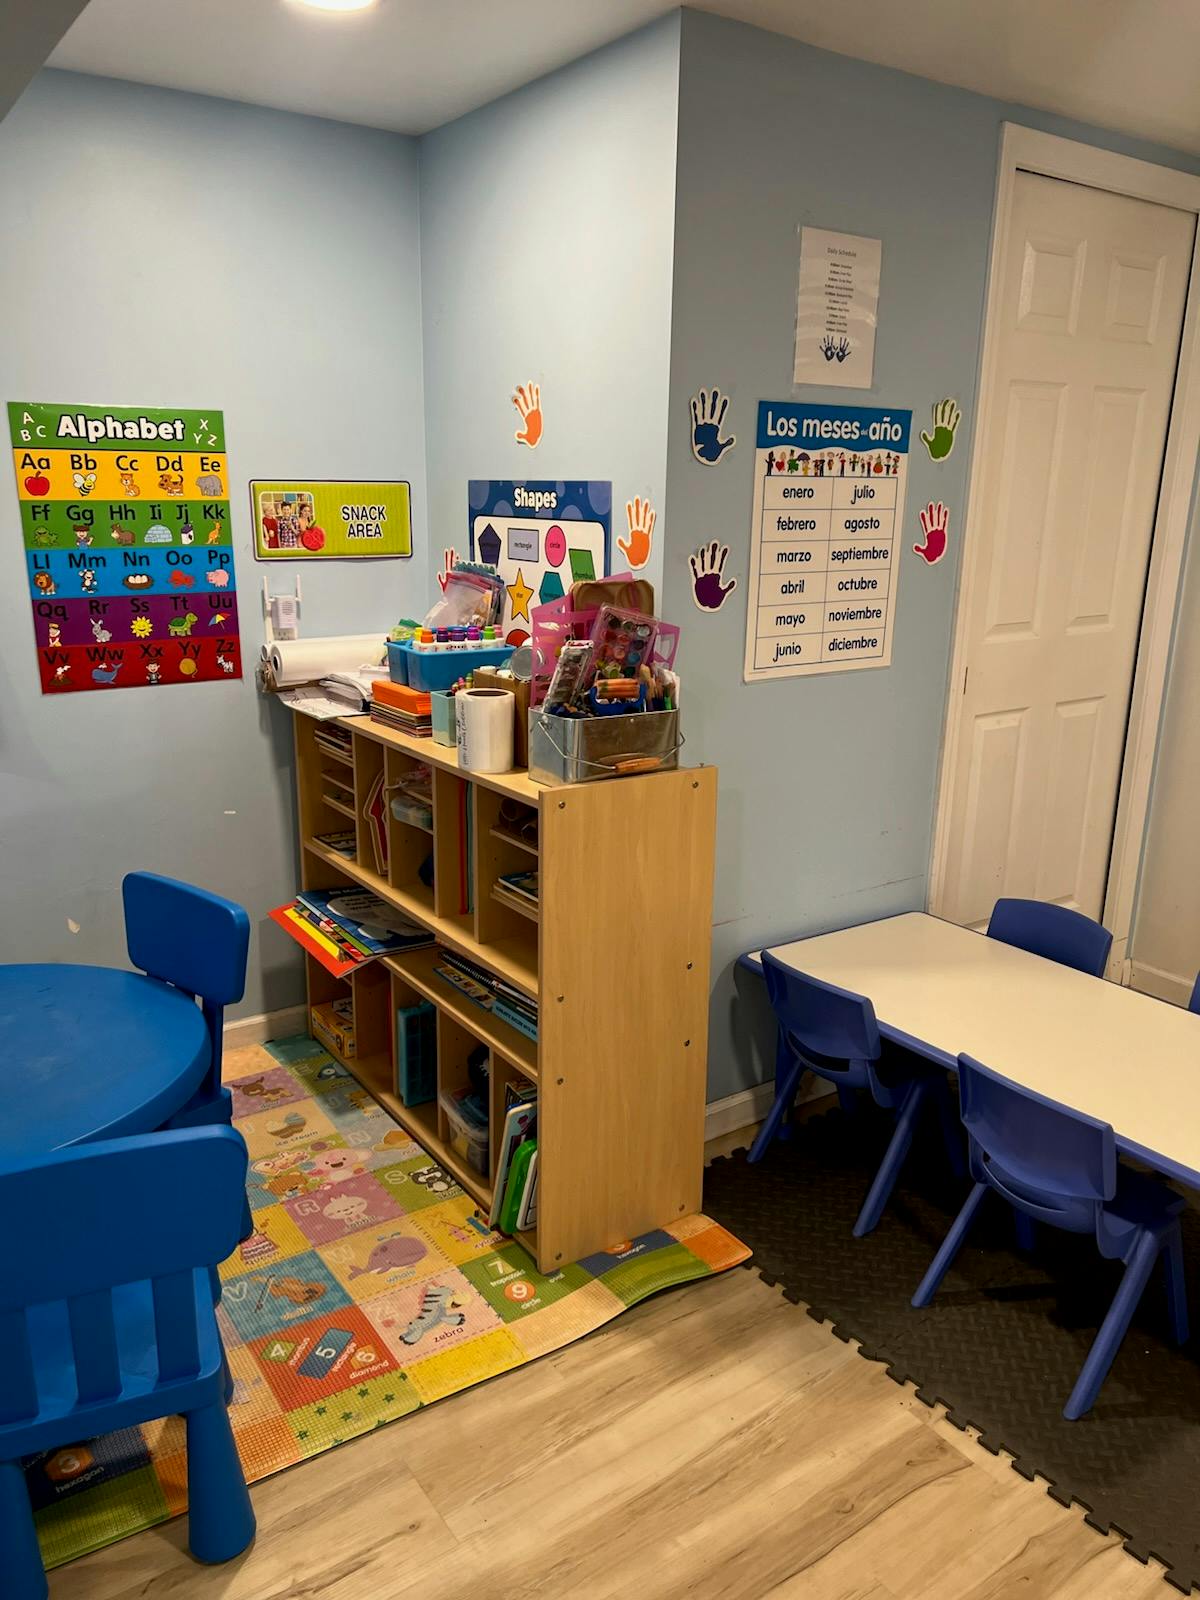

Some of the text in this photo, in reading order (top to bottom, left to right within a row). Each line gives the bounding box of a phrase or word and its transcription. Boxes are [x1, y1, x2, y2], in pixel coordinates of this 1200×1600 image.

[23, 411, 35, 424] A
[199, 418, 209, 431] X
[766, 410, 798, 438] Los
[802, 416, 860, 440] meses
[869, 415, 903, 442] año
[20, 425, 46, 442] B C
[58, 414, 185, 443] Alphabet
[193, 432, 217, 446] Y Z
[21, 453, 221, 472] Aa Bb Cc Dd Ee
[513, 486, 558, 512] Shapes
[783, 486, 815, 499] enero
[850, 484, 875, 504] julio
[32, 503, 226, 526] Ff Gg Hh Ii Jj Kk
[341, 504, 387, 522] SNACK
[347, 522, 383, 539] AREA
[776, 516, 816, 531] febrero
[844, 516, 880, 533] agosto
[33, 550, 230, 570] Ll Mm Nn Oo Pp
[776, 551, 812, 563] marzo
[830, 547, 889, 564] septiembre
[781, 579, 805, 595] abril
[837, 578, 878, 592] octubre
[37, 595, 233, 621] Qq Rr Ss Tt Uu
[828, 607, 882, 622] noviembre
[775, 612, 806, 628] mayo
[44, 639, 236, 664] Vv Ww Xx Yy Zz
[772, 642, 802, 663] junio
[828, 636, 878, 653] diciembre
[290, 1131, 319, 1143] cream
[294, 1198, 321, 1216] R
[488, 1258, 505, 1275] 7
[511, 1281, 528, 1298] 9
[521, 1297, 542, 1310] circle
[433, 1325, 465, 1343] zebra
[270, 1342, 286, 1358] 4
[315, 1345, 337, 1359] 5
[356, 1351, 376, 1364] 6
[349, 1359, 389, 1380] diamond
[60, 1454, 81, 1474] 3
[55, 1465, 105, 1493] hexagon
